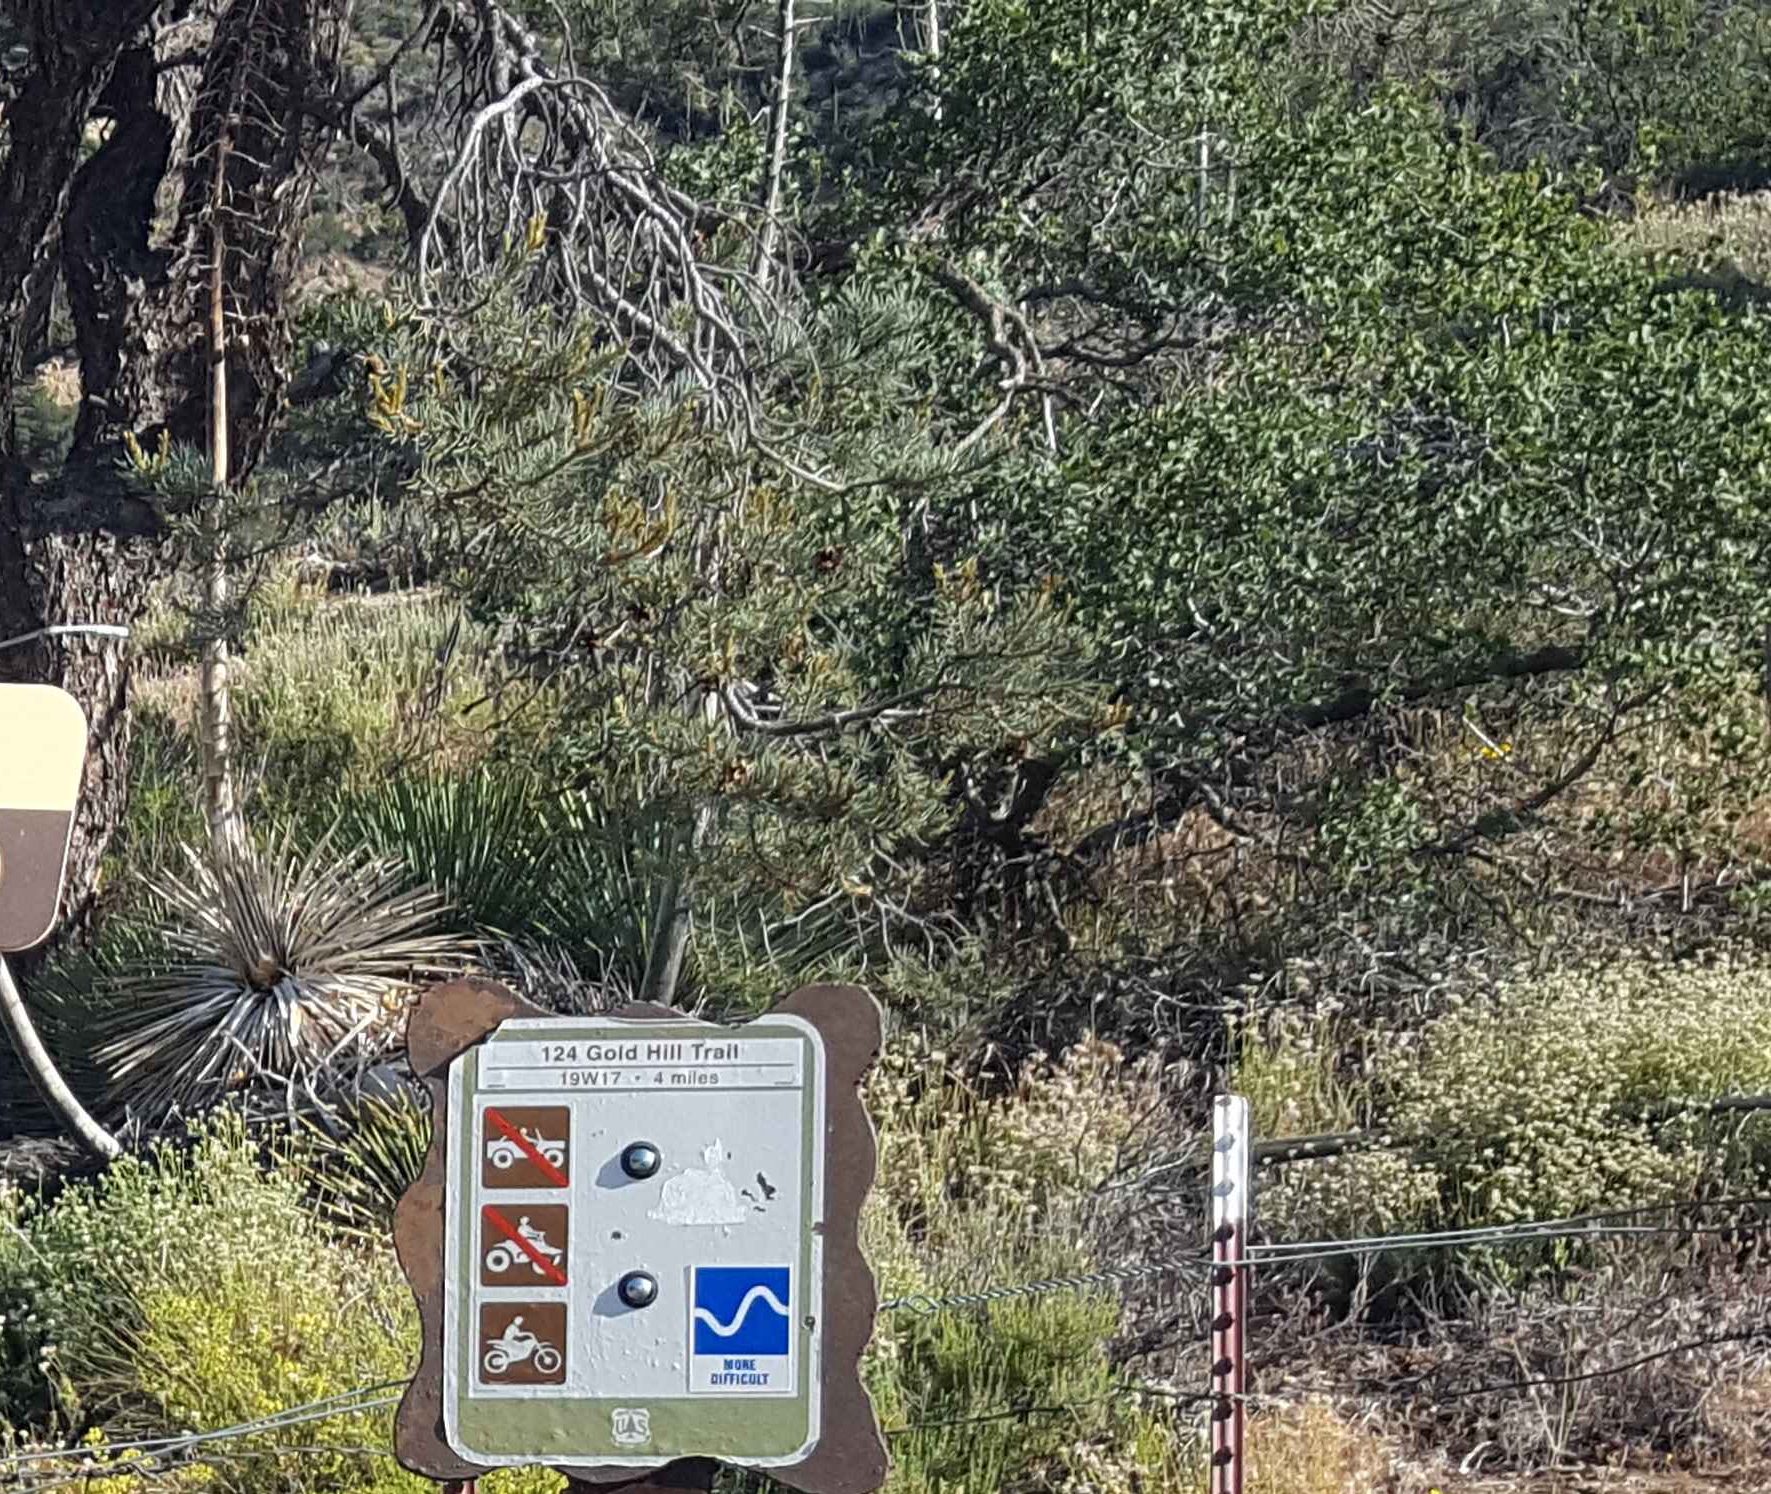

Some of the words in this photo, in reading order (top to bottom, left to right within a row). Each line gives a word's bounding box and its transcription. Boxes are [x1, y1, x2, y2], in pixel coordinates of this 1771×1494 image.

[542, 1045, 578, 1062] 124
[586, 1043, 639, 1062] Gold
[646, 1043, 683, 1061] Hill
[691, 1042, 740, 1060] Trail
[560, 1070, 622, 1086] 19W17
[653, 1071, 665, 1086] 4
[671, 1070, 720, 1086] miles
[724, 1359, 756, 1370] MORE
[710, 1374, 769, 1385] DIFFICULT
